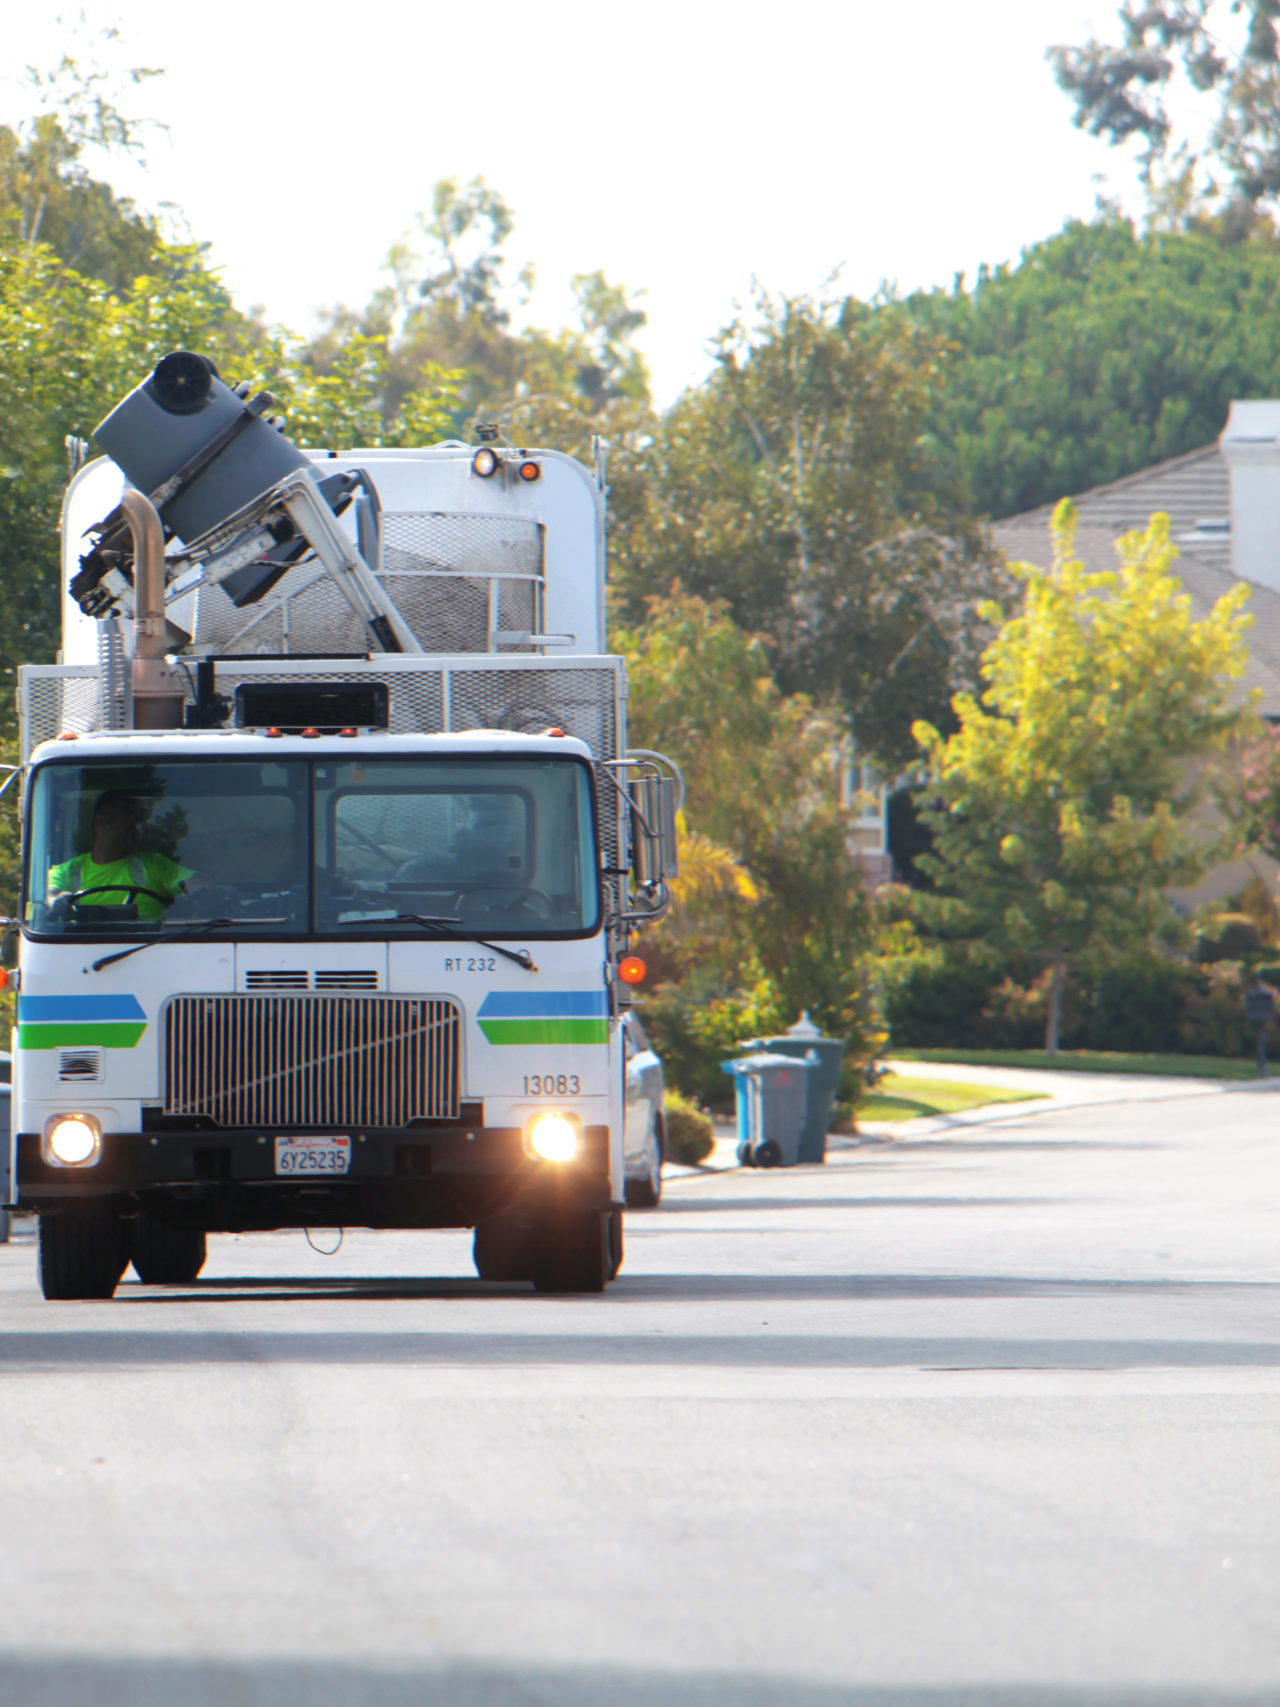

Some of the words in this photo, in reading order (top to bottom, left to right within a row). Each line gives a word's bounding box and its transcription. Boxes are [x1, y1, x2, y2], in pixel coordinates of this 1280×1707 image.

[444, 957, 463, 972] RT
[467, 957, 497, 972] 232
[523, 1074, 582, 1096] 13083
[279, 1149, 347, 1170] 6Y25235
